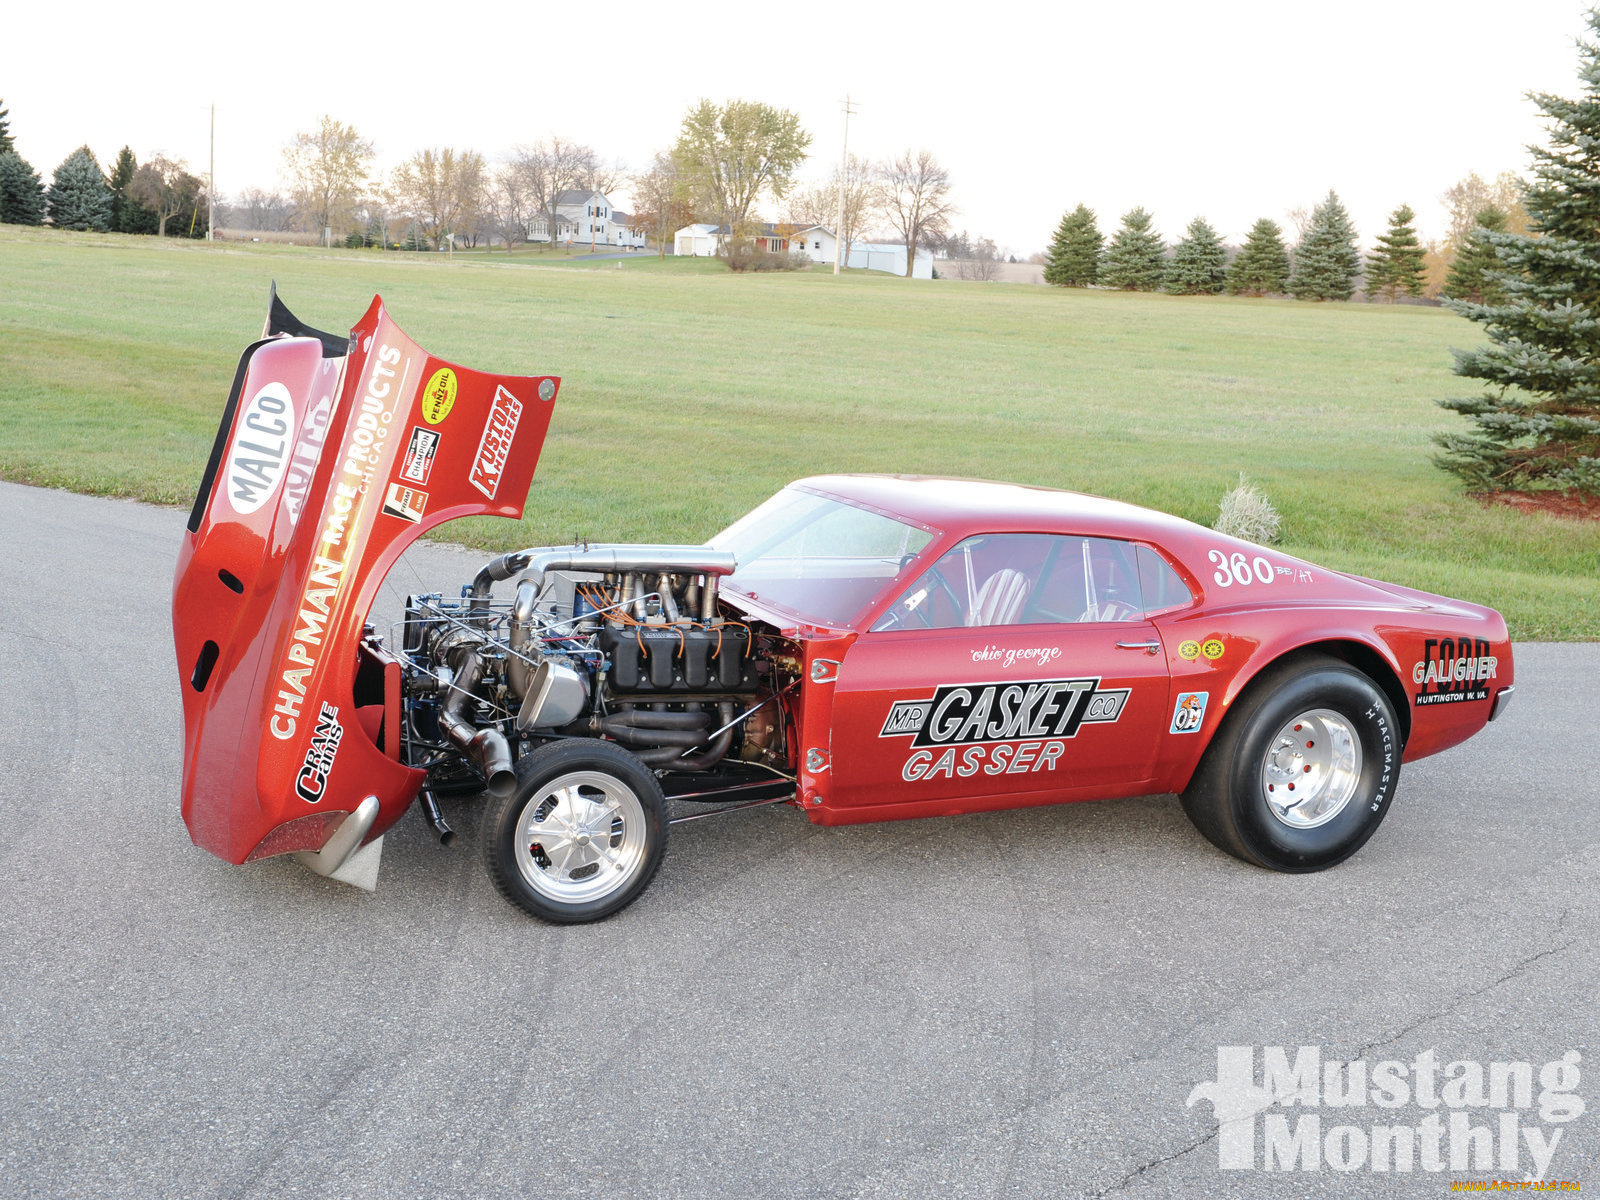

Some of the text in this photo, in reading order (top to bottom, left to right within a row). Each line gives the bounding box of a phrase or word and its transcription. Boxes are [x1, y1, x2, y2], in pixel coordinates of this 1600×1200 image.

[431, 373, 450, 421] PENNZOIL
[234, 396, 287, 504] MALCO
[357, 410, 393, 495] CHICAGO
[411, 434, 431, 477] CHAMPION
[473, 389, 514, 496] KUSTOM
[493, 401, 520, 472] HEADERS
[401, 490, 412, 514] FRAM
[270, 344, 401, 740] CHAPMAN RACE PRODUCTS
[1208, 550, 1275, 588] 360
[1002, 647, 1063, 668] george
[1412, 656, 1498, 684] GALIGHER
[888, 682, 1117, 743] MR. GASKET CO.
[1416, 693, 1464, 705] HUNTINGTON
[902, 741, 1065, 782] GASSER
[1370, 717, 1392, 812] RACEMASTER
